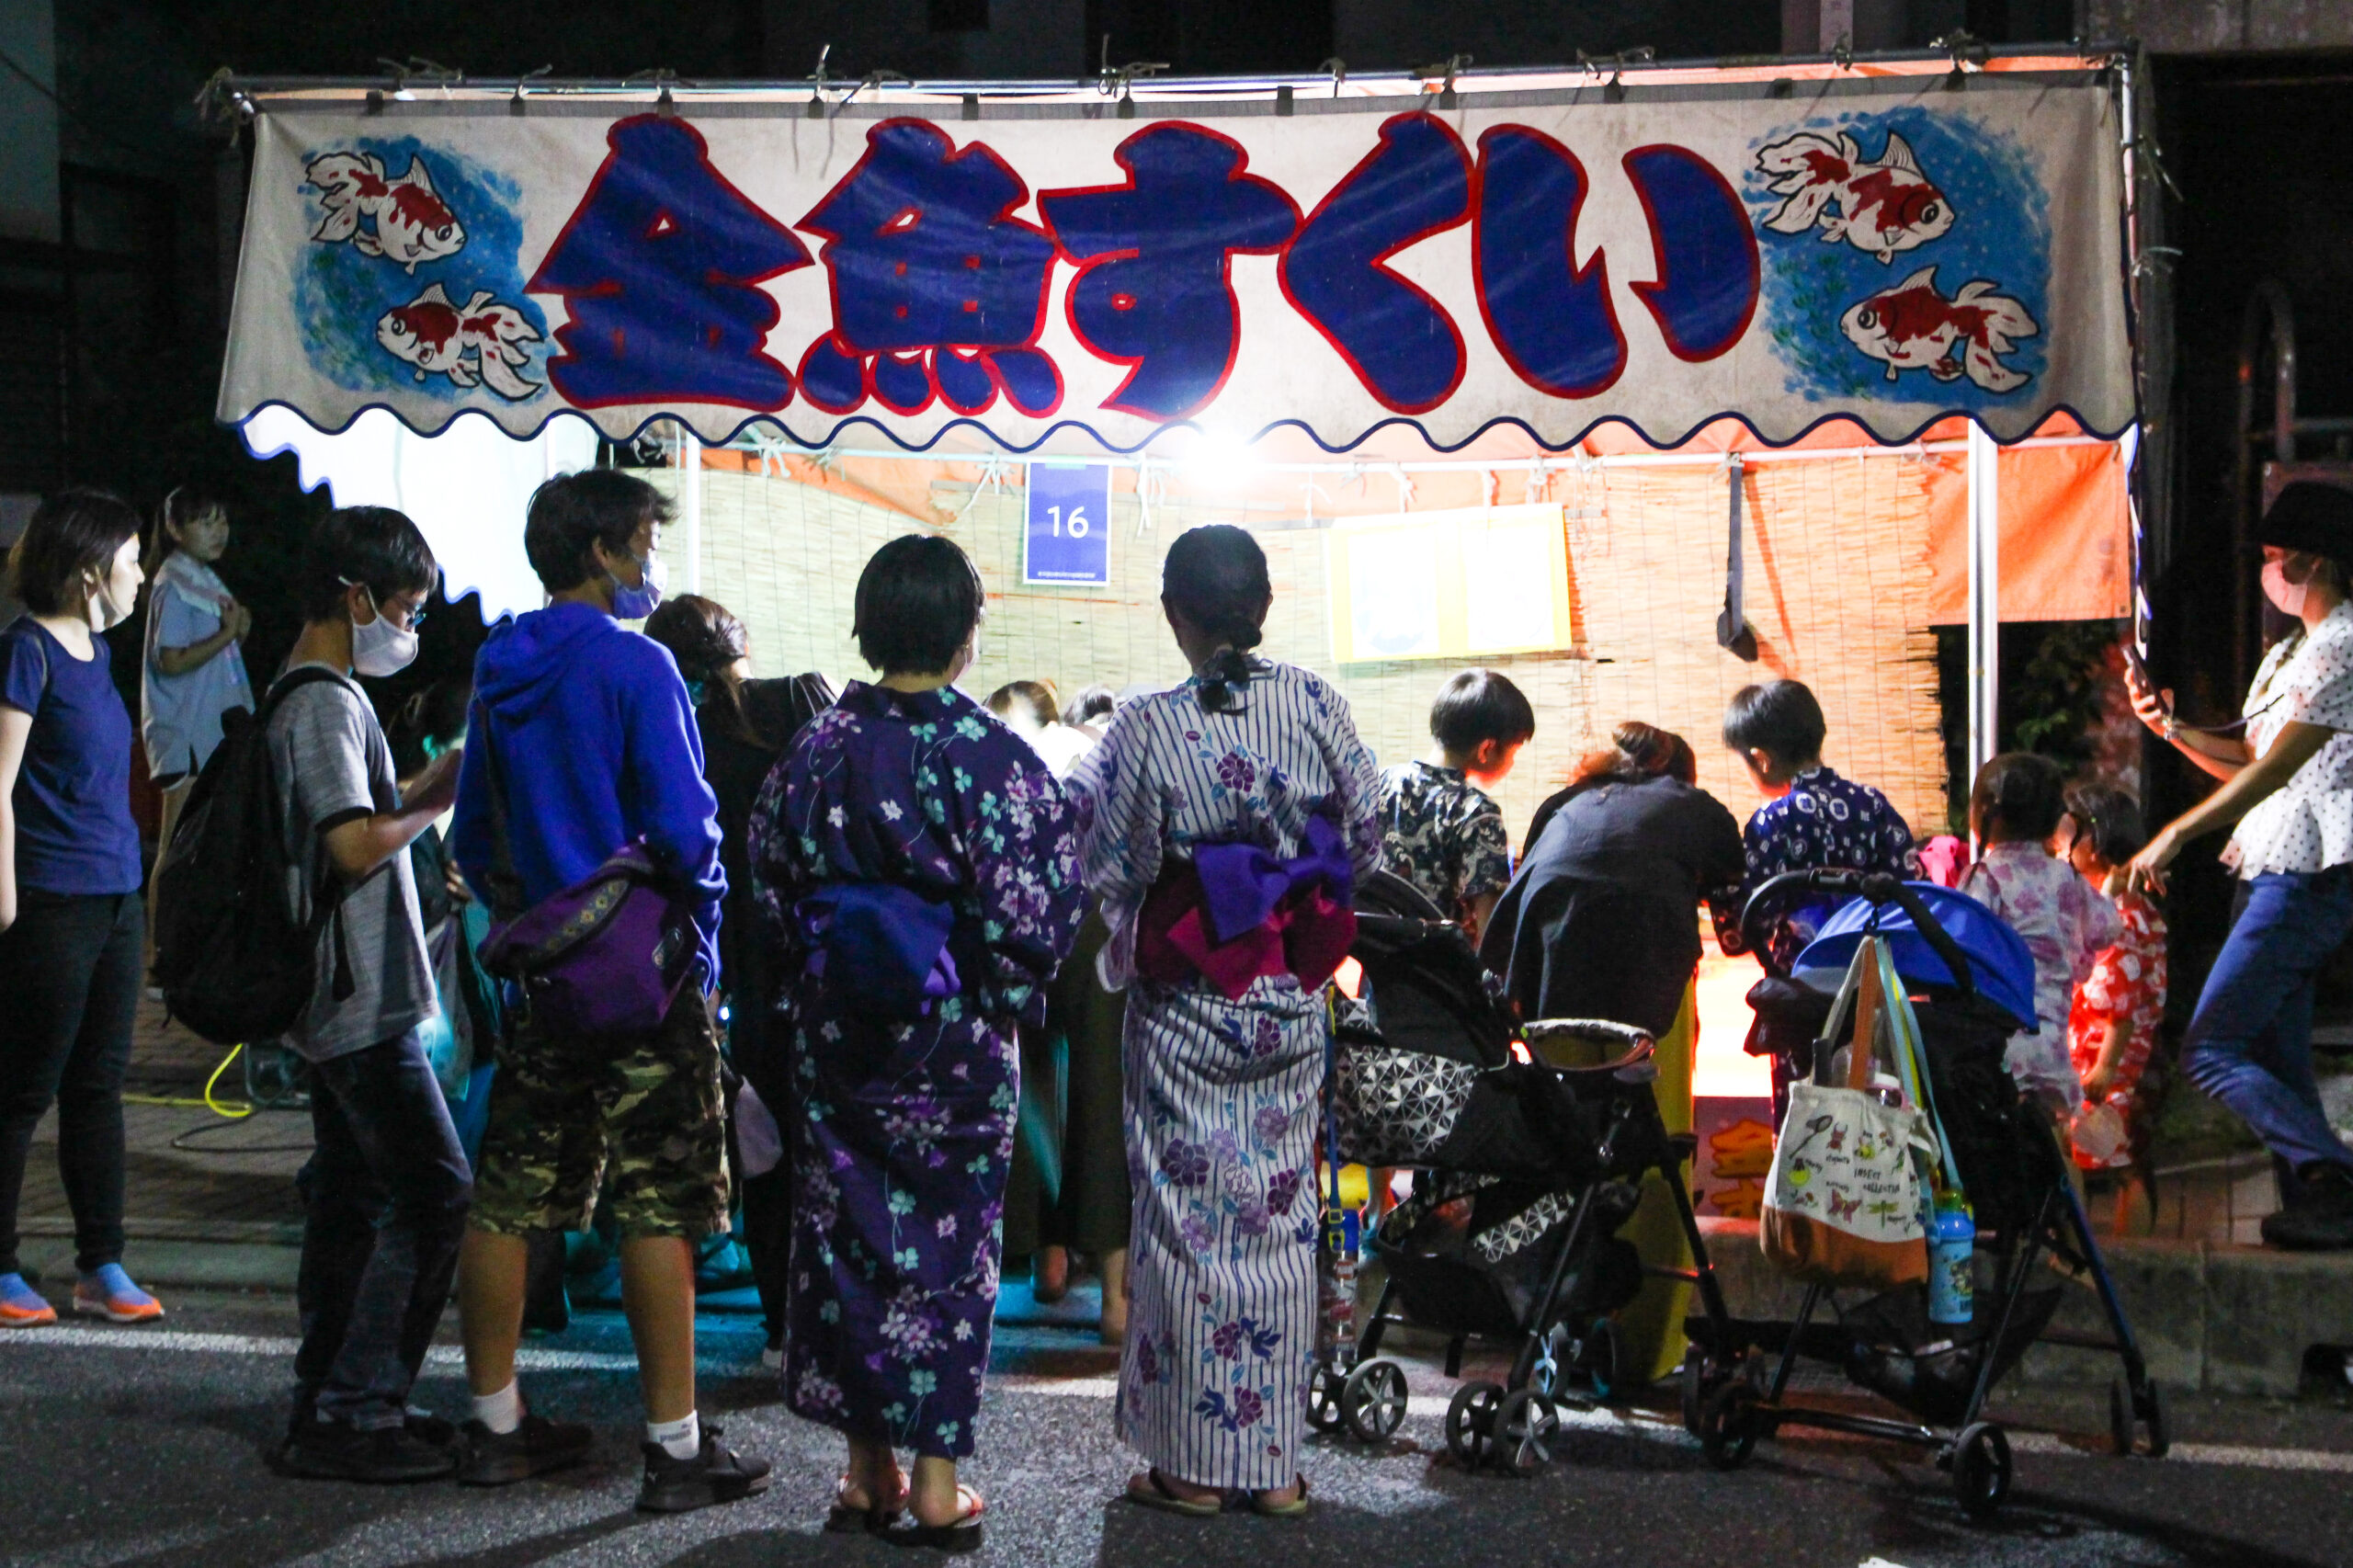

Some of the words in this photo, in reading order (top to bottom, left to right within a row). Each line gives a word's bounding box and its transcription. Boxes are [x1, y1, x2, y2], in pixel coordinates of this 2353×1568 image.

[523, 111, 1761, 423] 金魚すくい
[1047, 506, 1089, 539] 16
